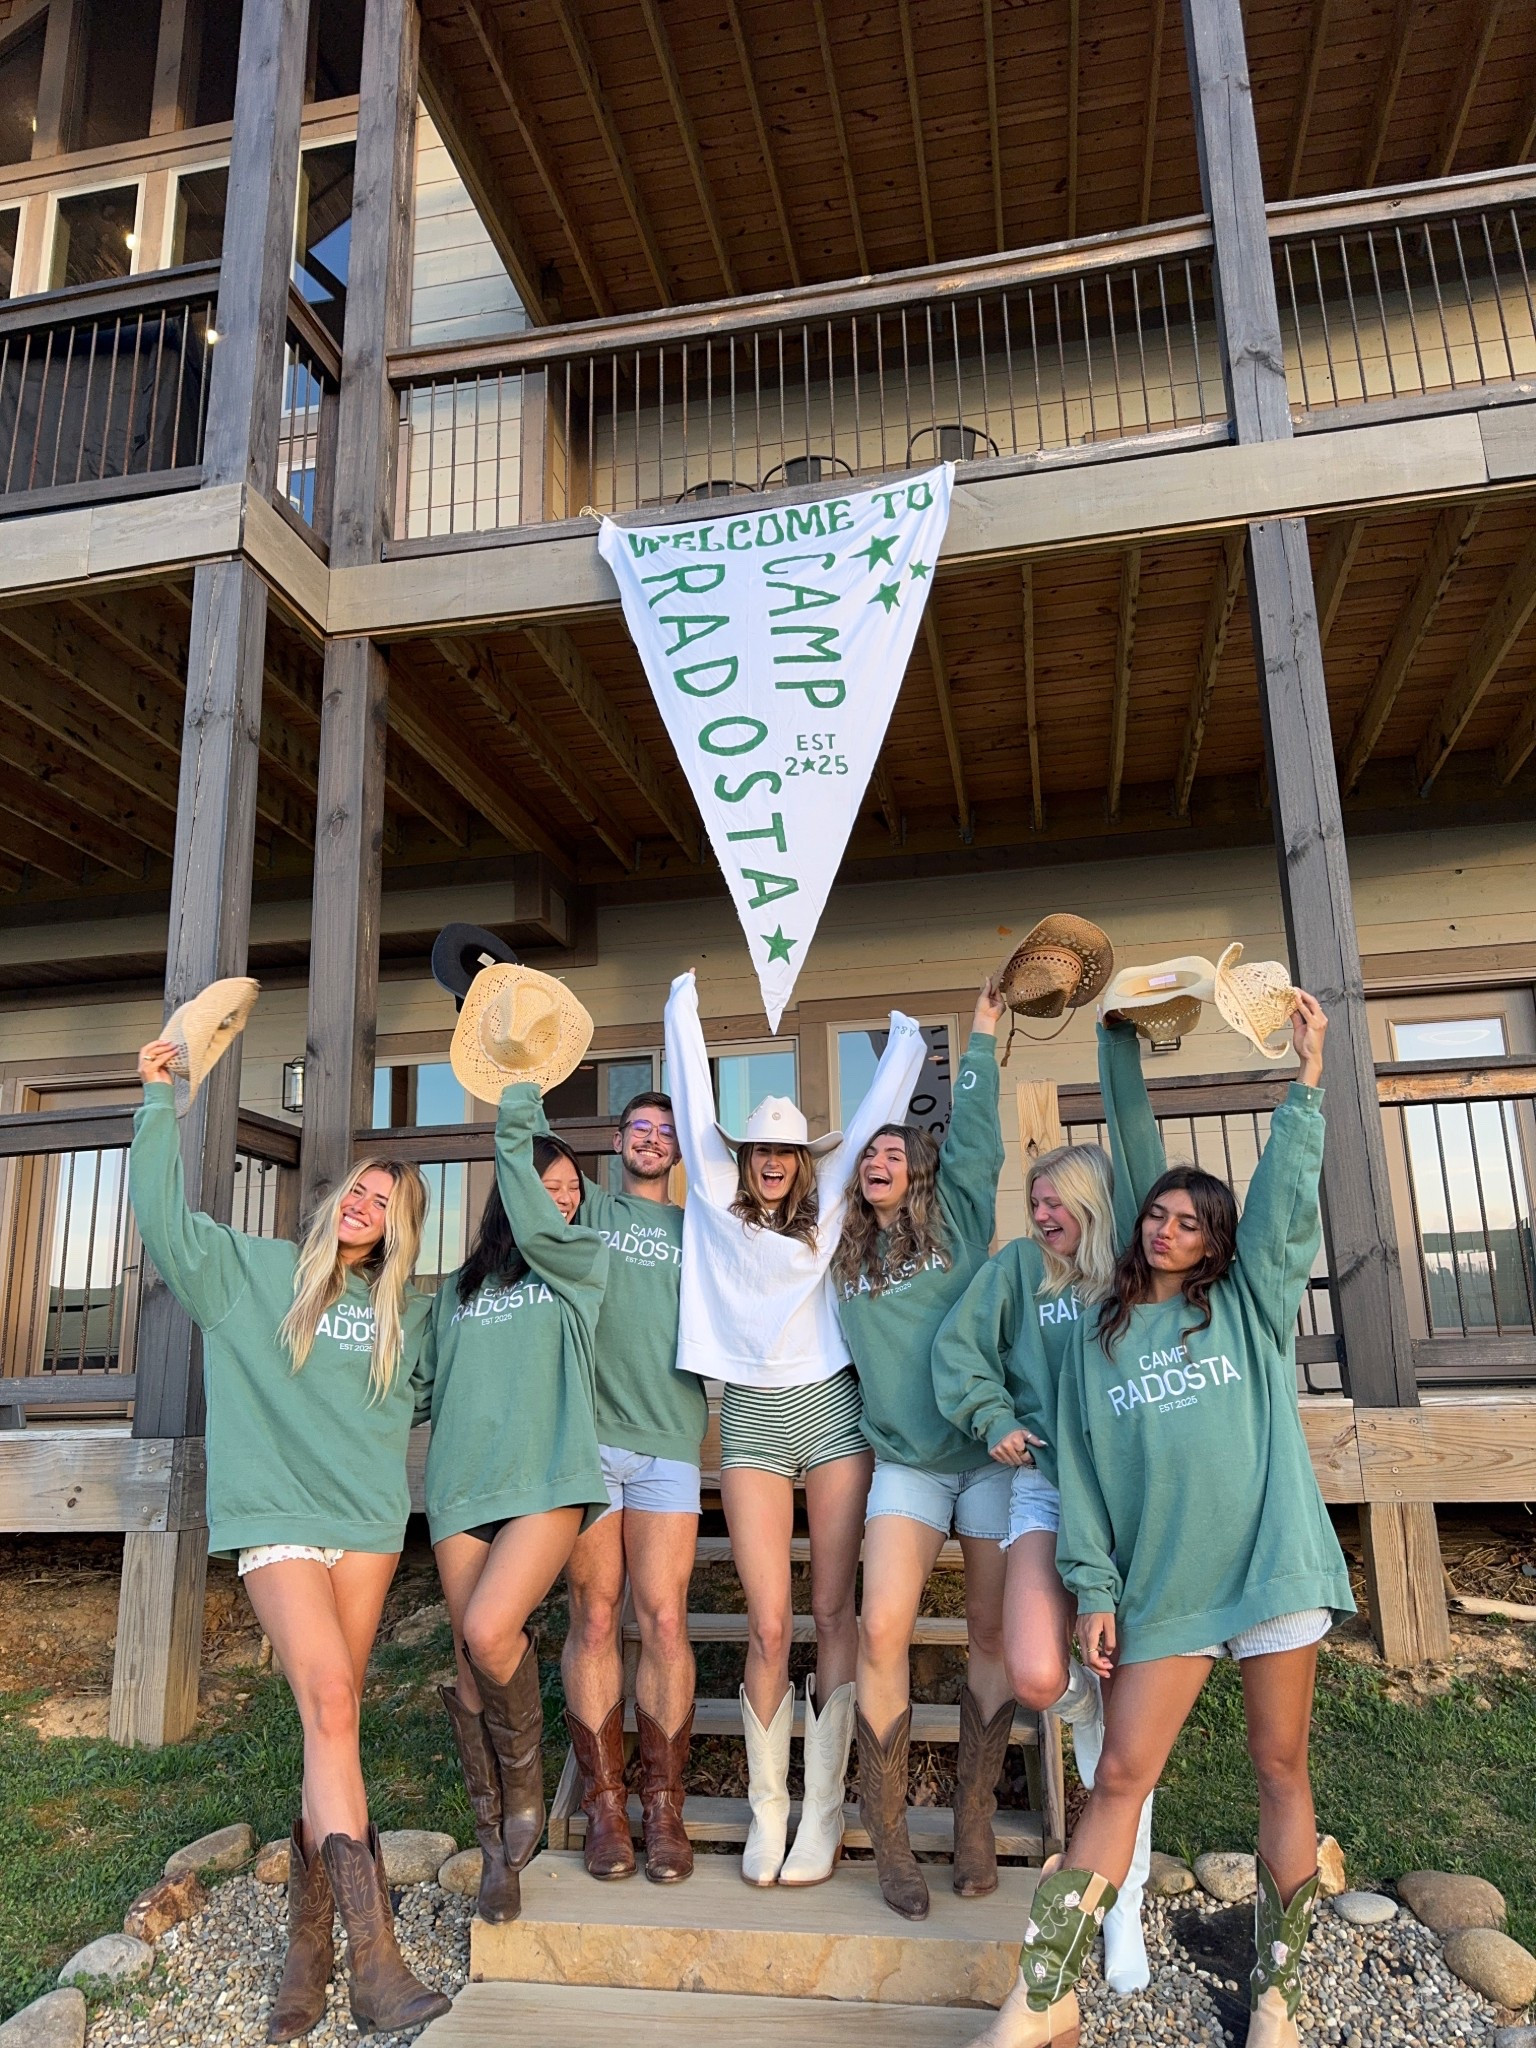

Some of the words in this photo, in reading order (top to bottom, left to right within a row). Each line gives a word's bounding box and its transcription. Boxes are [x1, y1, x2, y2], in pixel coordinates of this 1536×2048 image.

[628, 500, 854, 558] WELCOME
[871, 482, 934, 519] TO
[762, 552, 846, 708] CAMP
[641, 564, 799, 909] RADOSTA
[796, 733, 836, 751] EST
[630, 1223, 667, 1238] CAMP
[597, 1230, 683, 1268] ADOST
[450, 1283, 554, 1327] RADOSTA
[481, 1317, 494, 1326] EST
[339, 1342, 353, 1351] EST
[1139, 1344, 1188, 1371] CAMP
[1107, 1355, 1242, 1416] RADOSTA
[1158, 1401, 1174, 1413] EST
[1175, 1395, 1198, 1409] 2025
